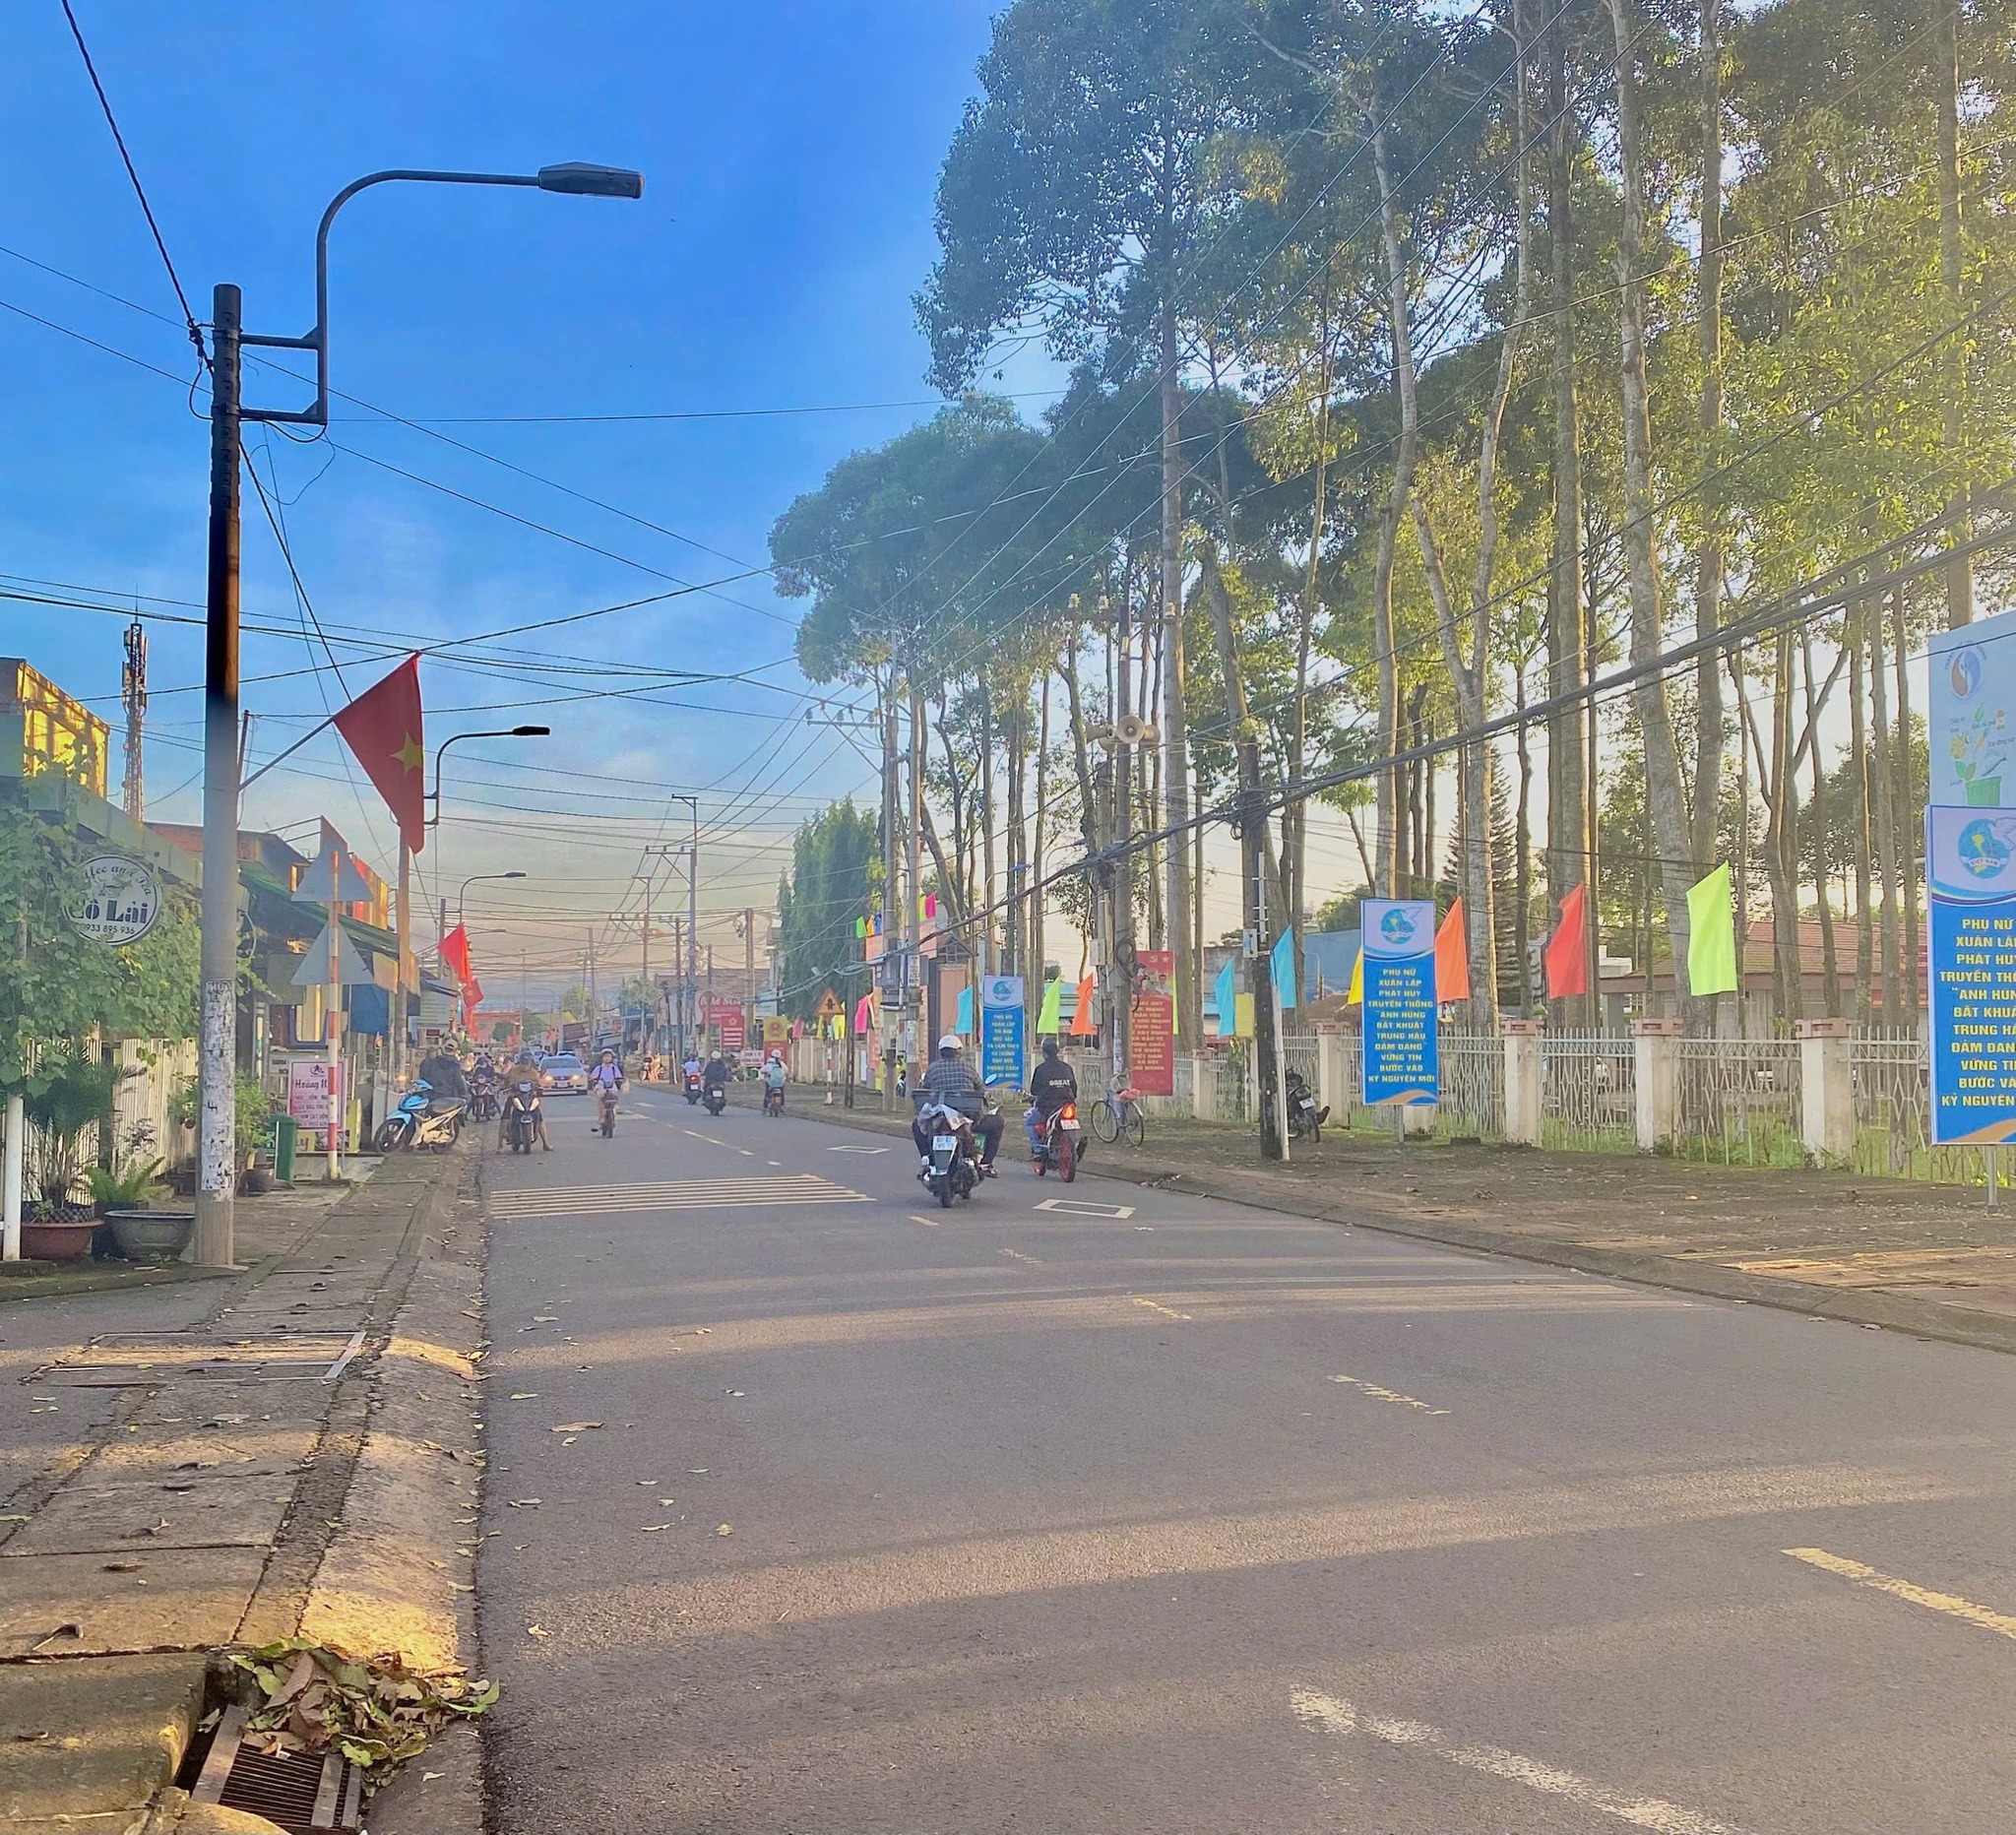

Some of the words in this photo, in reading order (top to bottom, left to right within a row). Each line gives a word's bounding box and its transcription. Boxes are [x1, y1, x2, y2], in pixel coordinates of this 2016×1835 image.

[1963, 919, 1989, 932] PHỤ
[1994, 918, 2014, 930] NỮ
[1956, 935, 1993, 947] XUÂN
[1997, 935, 2016, 949] LẬ
[1957, 953, 1990, 965] PHÁT
[1995, 955, 2016, 965] HU
[1939, 969, 1991, 982] TRUYỀN
[1954, 1005, 1979, 1018] BẤT
[1953, 1025, 1997, 1036] TRUNG
[1952, 1040, 1983, 1053] ĐẢM
[1961, 1058, 1997, 1071] VỮNG
[2002, 1060, 2016, 1071] TI
[1959, 1076, 1995, 1089] BƯỚC
[1942, 1093, 1958, 1107] KỶ
[1963, 1094, 2015, 1107] NGUYÊN
